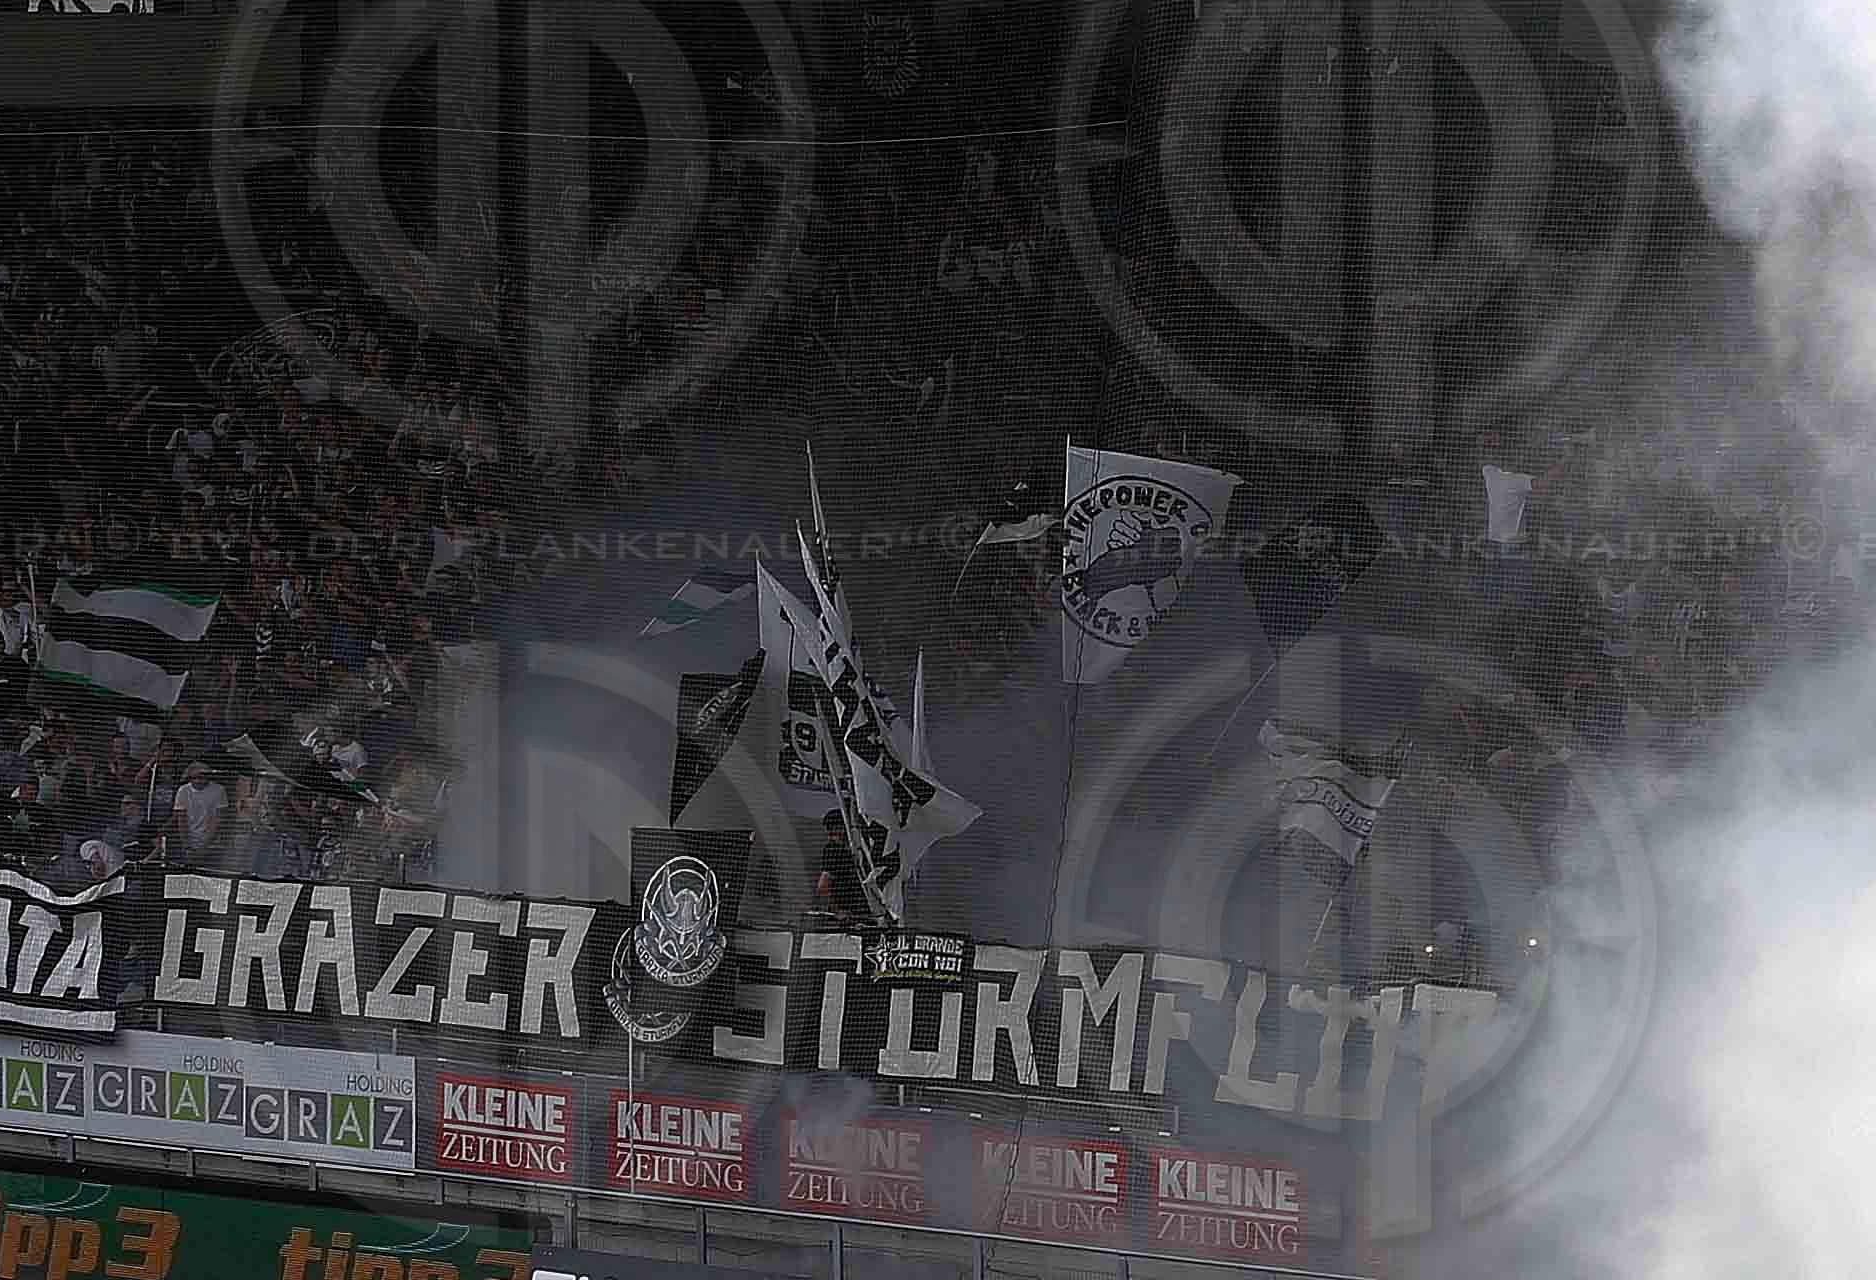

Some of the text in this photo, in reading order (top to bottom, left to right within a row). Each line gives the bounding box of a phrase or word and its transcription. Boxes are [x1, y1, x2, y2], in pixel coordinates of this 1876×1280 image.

[1067, 485, 1189, 544] THE POWER
[154, 873, 597, 1038] GRAZER
[20, 1040, 85, 1063] HOLDING
[182, 1055, 244, 1074] HOLDING
[97, 1071, 239, 1123] GRAZ
[346, 1073, 413, 1096] HOLDING
[442, 1080, 566, 1134] KLEINE
[249, 1093, 407, 1147] GRAZ
[617, 1100, 743, 1152] KLEINE
[441, 1131, 567, 1174] ZEITUNG
[614, 1150, 745, 1194] ZEITUNG
[1157, 1157, 1301, 1212] KLEINE
[1157, 1211, 1301, 1256] ZEITUNG
